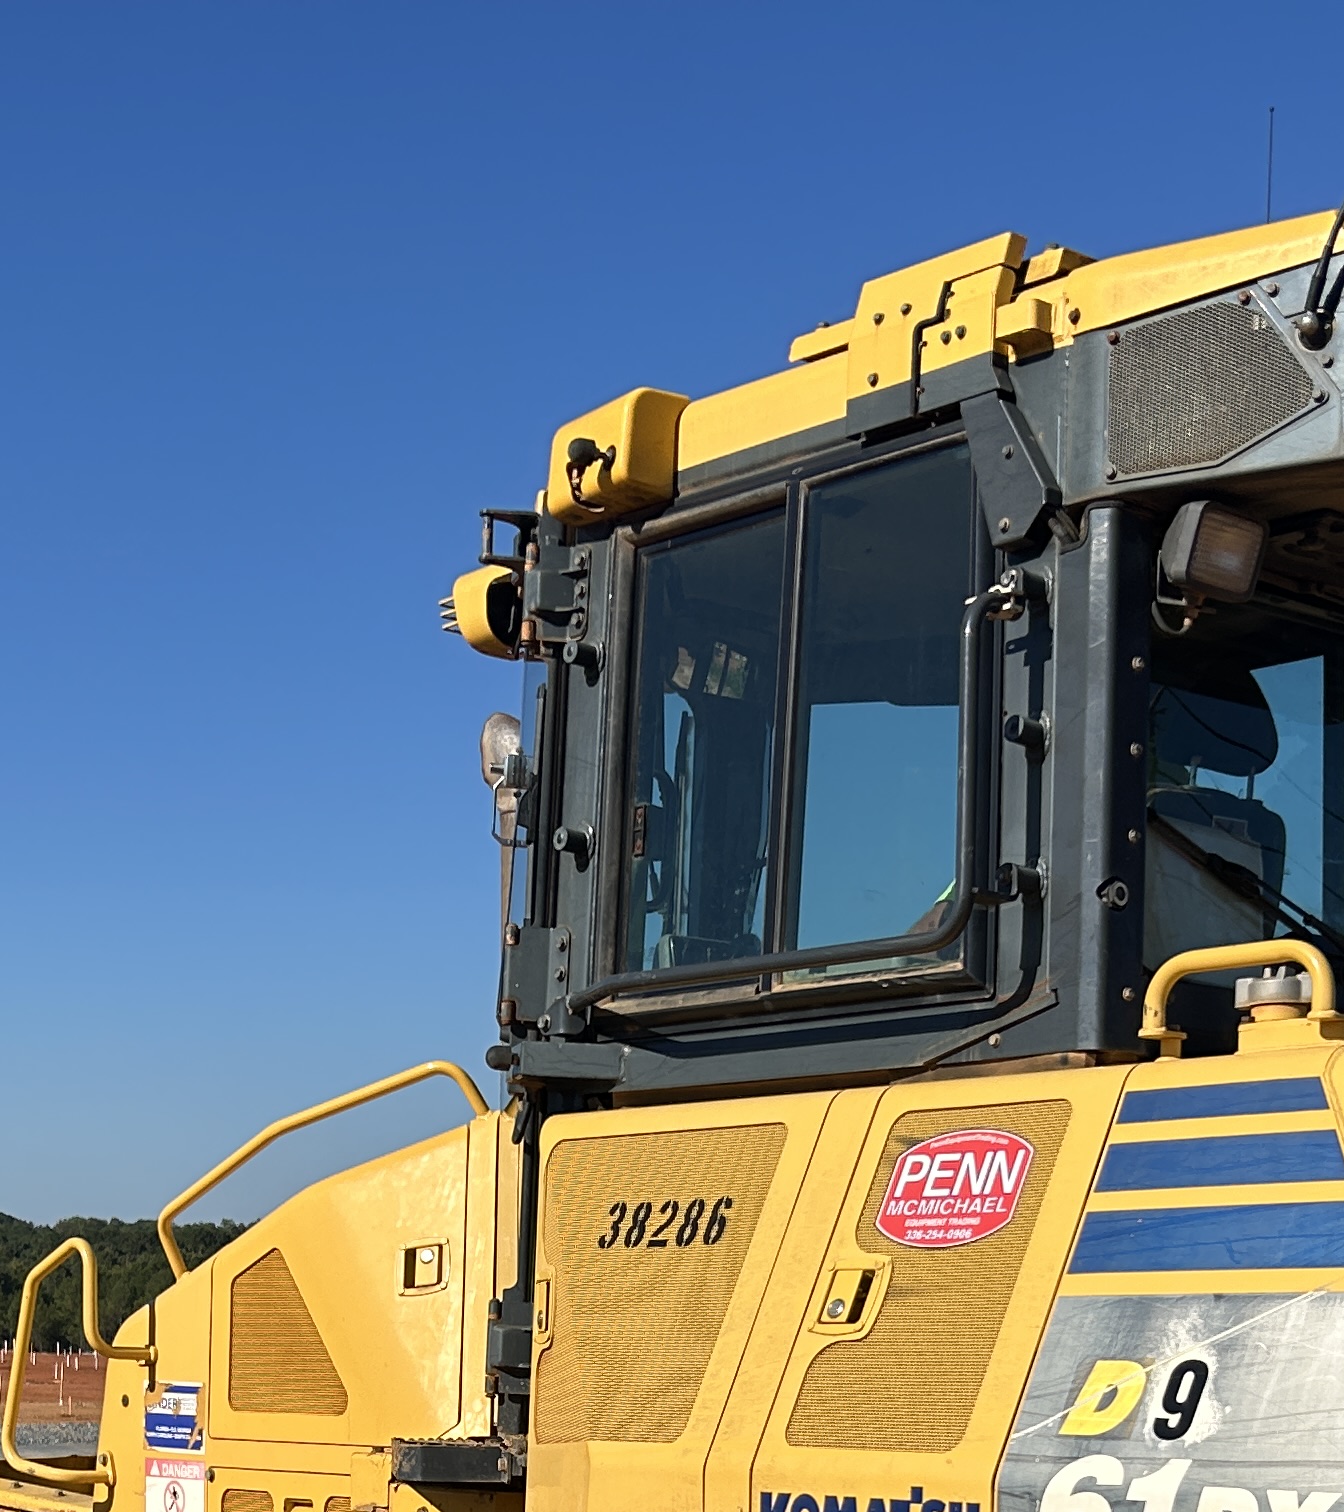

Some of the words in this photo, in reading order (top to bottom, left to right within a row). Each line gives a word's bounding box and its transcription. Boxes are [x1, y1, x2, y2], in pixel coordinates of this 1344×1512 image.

[893, 1149, 1027, 1198] PENN
[598, 1195, 733, 1249] 38286
[885, 1196, 1009, 1216] MCMICHAEL
[161, 1463, 201, 1479] DANGER
